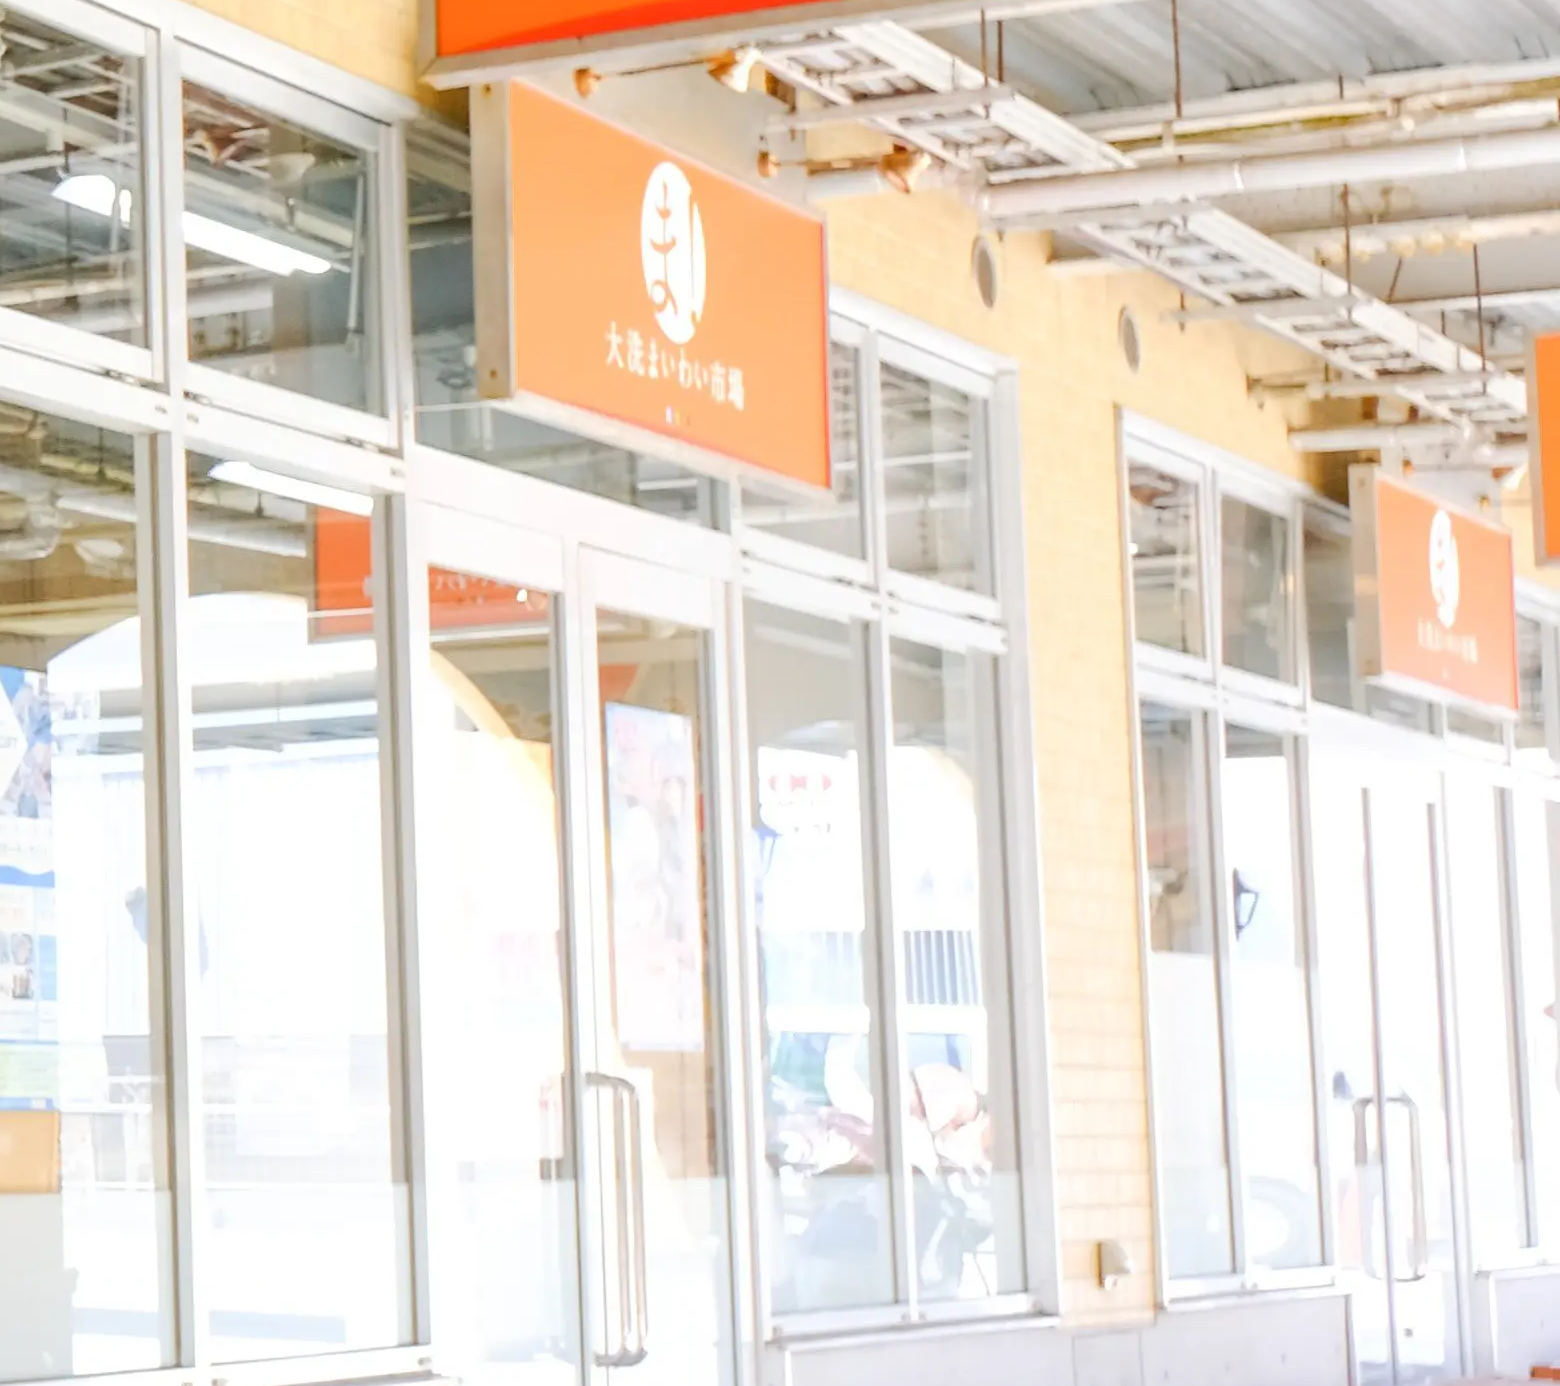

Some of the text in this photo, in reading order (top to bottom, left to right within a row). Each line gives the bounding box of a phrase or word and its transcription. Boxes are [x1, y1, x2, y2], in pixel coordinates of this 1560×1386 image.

[605, 320, 746, 412] 大洗まいわい市場
